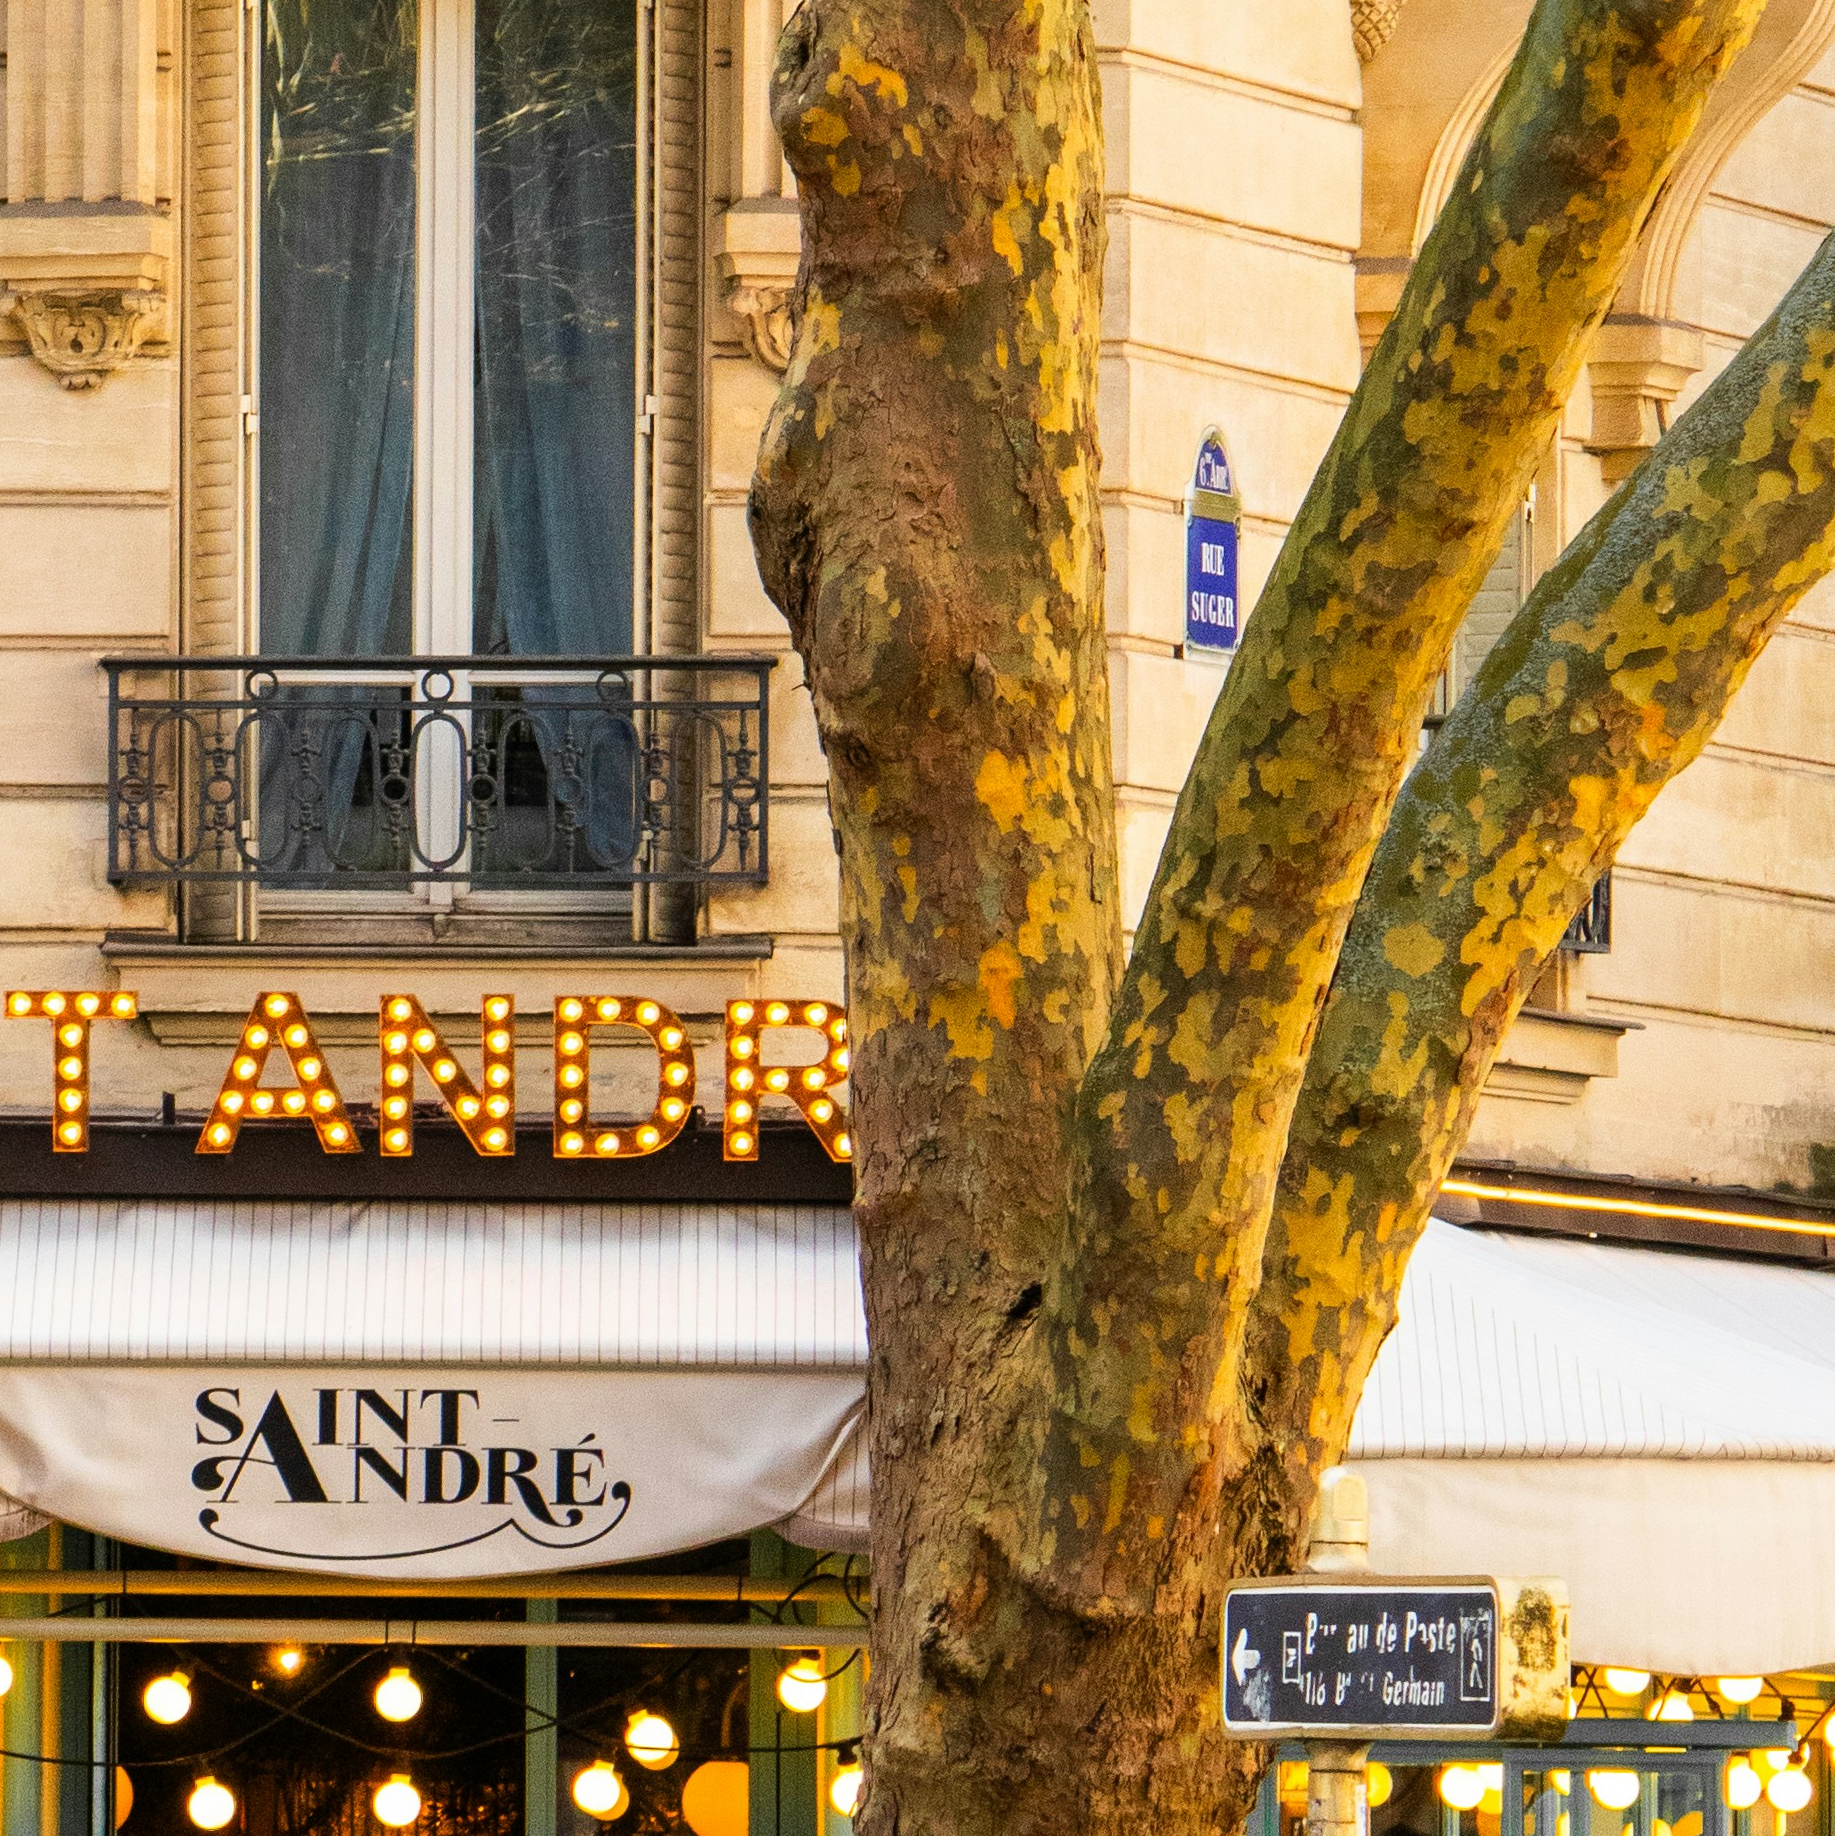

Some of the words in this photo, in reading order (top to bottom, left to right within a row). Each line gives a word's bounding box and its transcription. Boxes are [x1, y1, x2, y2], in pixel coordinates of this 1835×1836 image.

[1201, 543, 1224, 576] RUE
[1192, 591, 1235, 628] SUGER
[191, 1415, 610, 1527] ANDRÉ
[1375, 1611, 1398, 1654] de
[1382, 1665, 1446, 1706] Germain
